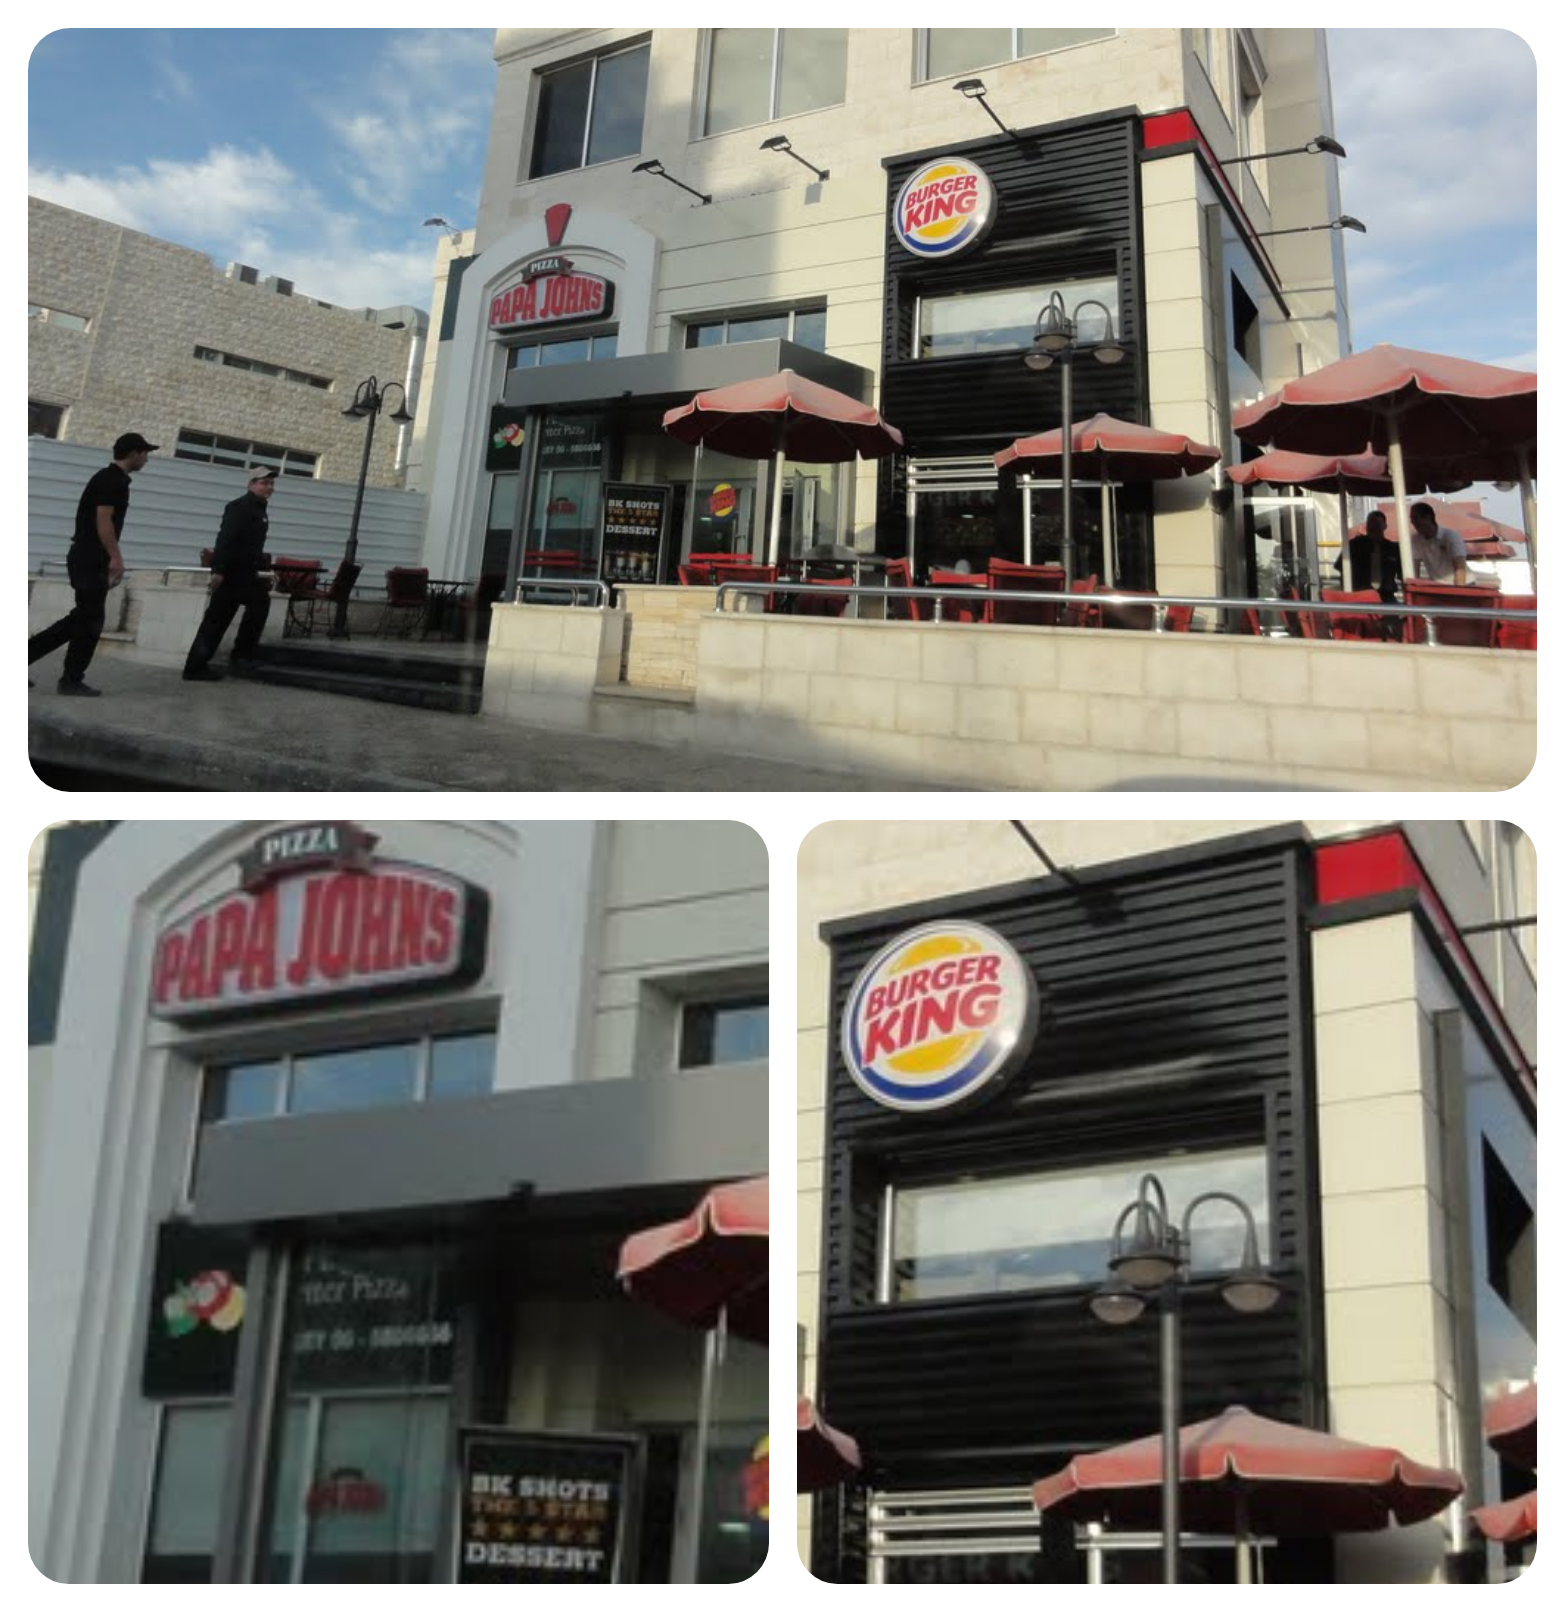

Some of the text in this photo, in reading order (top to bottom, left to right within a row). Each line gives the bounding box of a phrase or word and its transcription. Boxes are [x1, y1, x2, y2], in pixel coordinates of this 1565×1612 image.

[905, 175, 978, 209] BURGER
[904, 191, 978, 233] KING
[531, 259, 559, 273] PIZZA
[491, 282, 536, 324] PAPA
[608, 499, 660, 510] BK SHOTS
[606, 524, 657, 536] DESSERT
[263, 829, 339, 862] PIZZA
[154, 892, 276, 1002] PAPA
[865, 954, 1001, 1016] BURGER
[862, 983, 1002, 1064] KING
[471, 1473, 610, 1501] BK SHOTS
[466, 1541, 605, 1570] DESSERT
